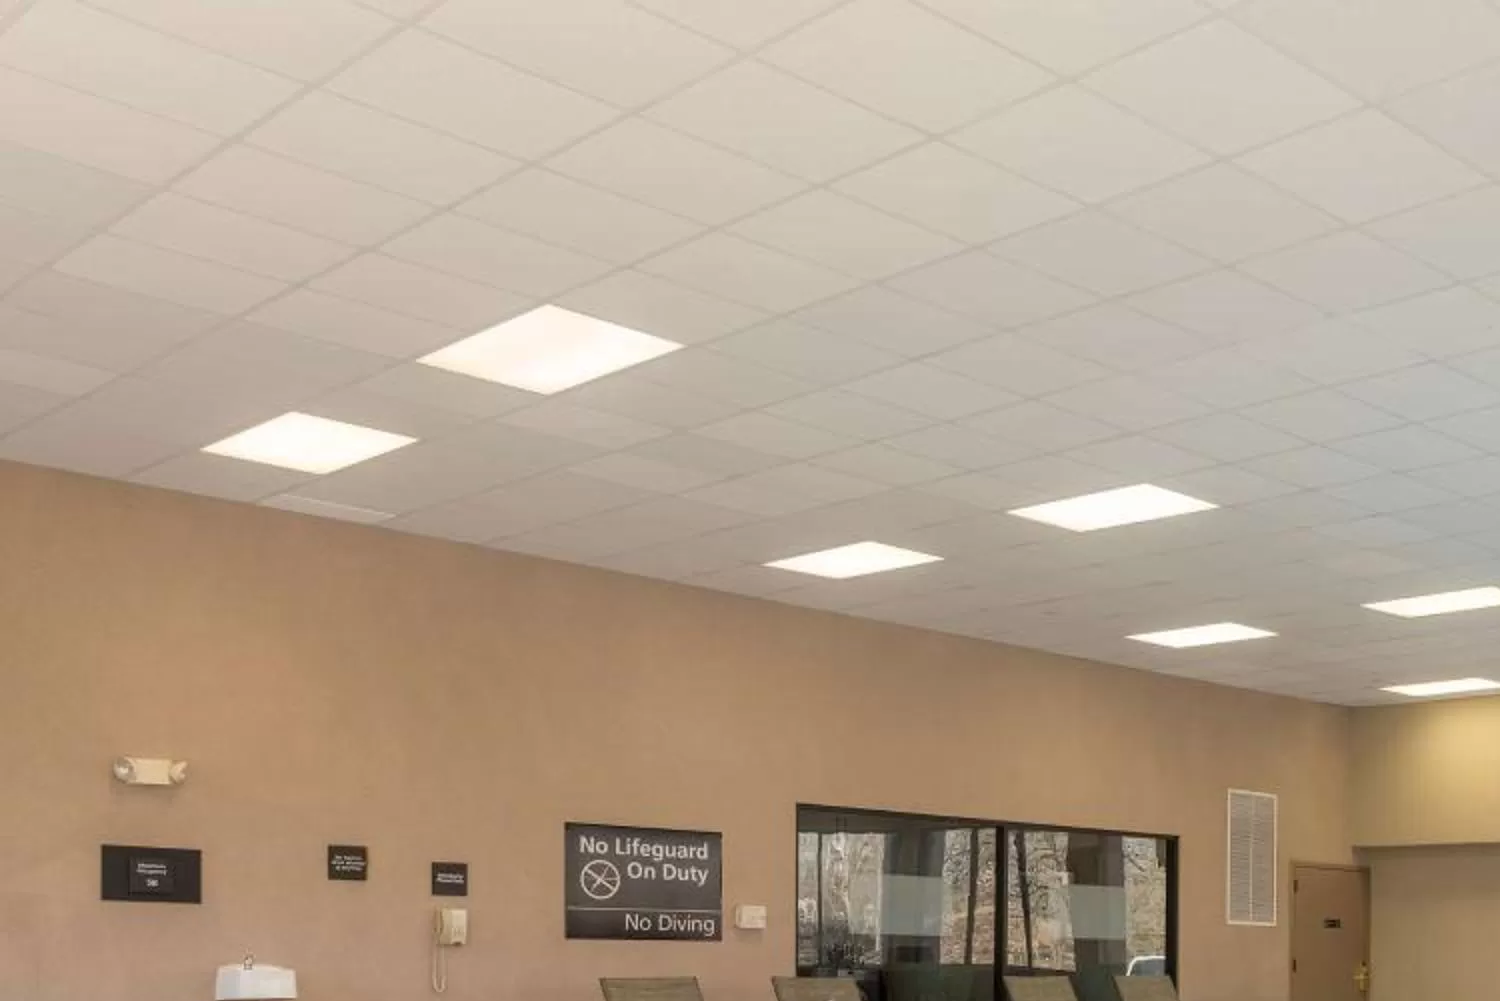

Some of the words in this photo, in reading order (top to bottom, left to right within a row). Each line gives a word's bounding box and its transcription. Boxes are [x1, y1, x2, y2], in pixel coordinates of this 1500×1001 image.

[579, 835, 608, 854] No
[615, 837, 709, 861] Lifeguard
[627, 861, 656, 880] On
[663, 863, 709, 887] Duty
[625, 913, 652, 932] No
[659, 914, 716, 937] Diving
